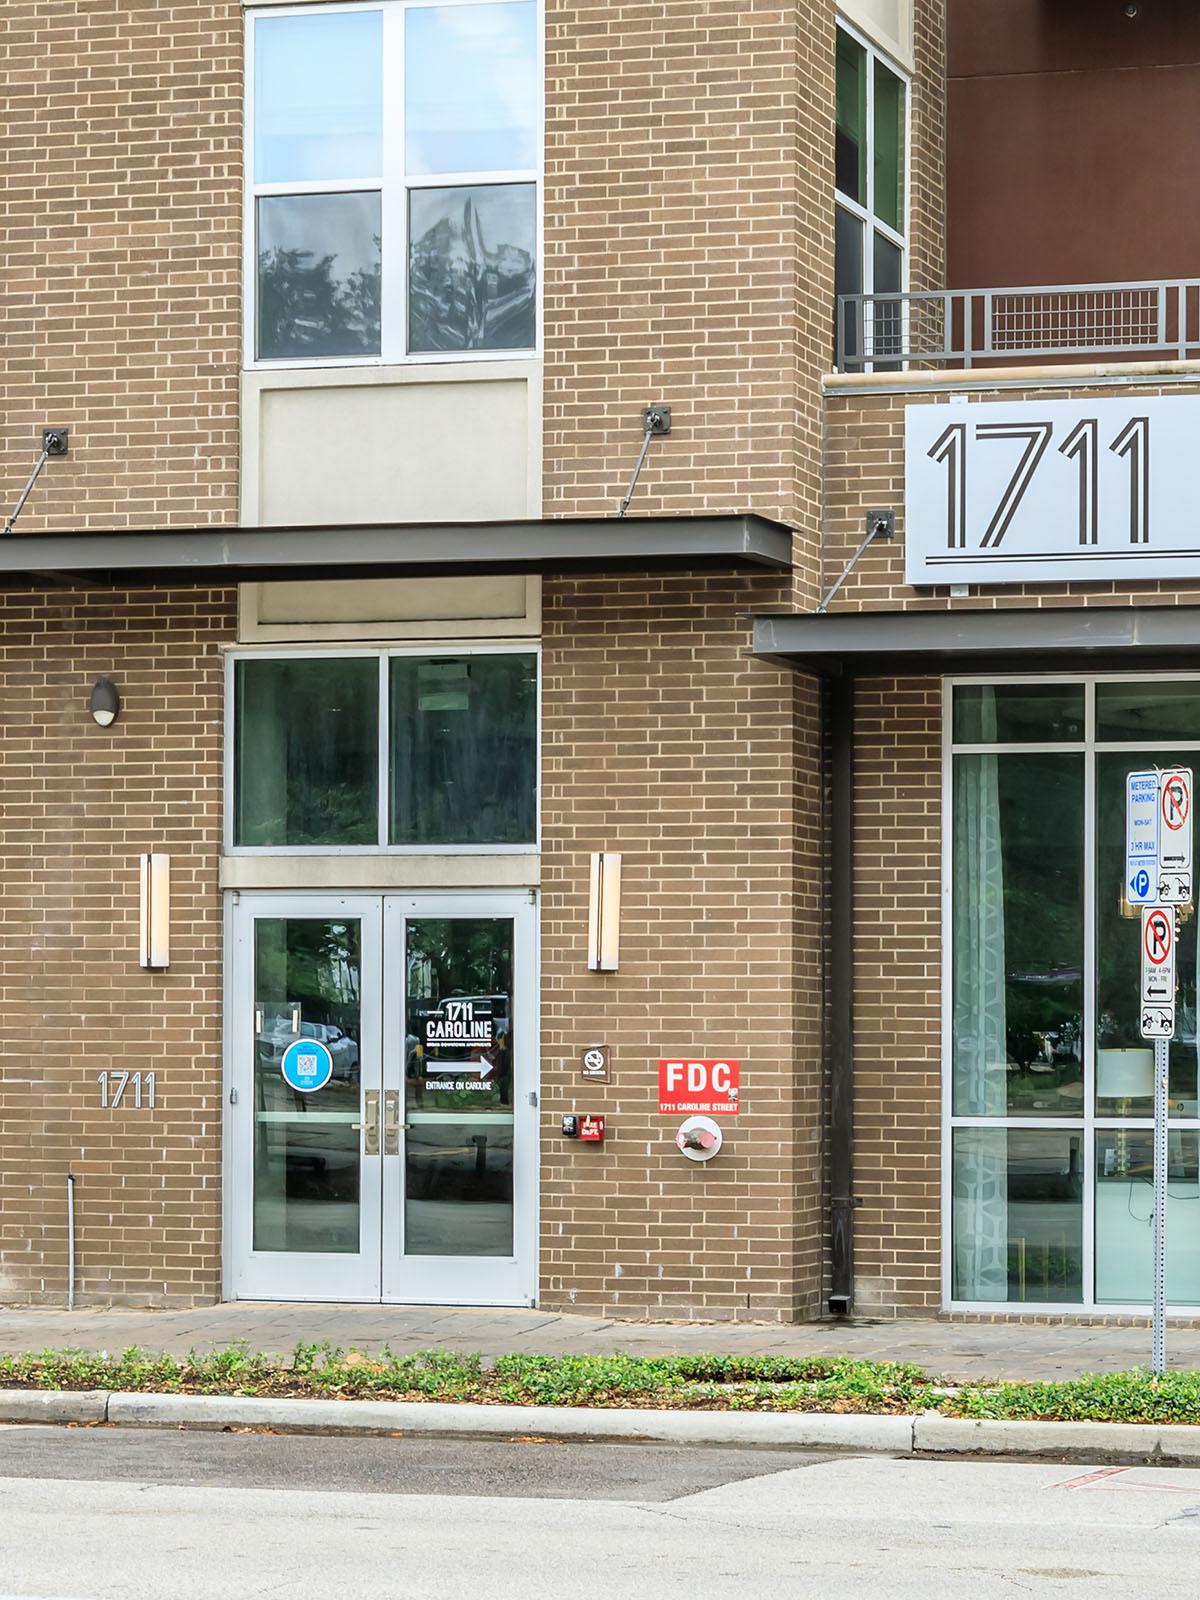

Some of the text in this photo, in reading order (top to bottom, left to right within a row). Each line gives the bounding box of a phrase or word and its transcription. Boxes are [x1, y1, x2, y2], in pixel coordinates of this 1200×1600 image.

[926, 416, 1151, 549] 1711
[1130, 780, 1156, 790] METERED
[1131, 793, 1156, 802] PARKING
[1135, 841, 1143, 850] HR
[1143, 840, 1155, 851] MAX
[446, 1002, 473, 1021] 1711
[426, 1021, 492, 1038] CAROLINE
[666, 1063, 731, 1092] FDC
[97, 1071, 155, 1108] 1711
[426, 1081, 492, 1091] ENTRANCE ON CAROLINE
[677, 1103, 711, 1111] CAROLINE
[712, 1103, 738, 1111] STREET
